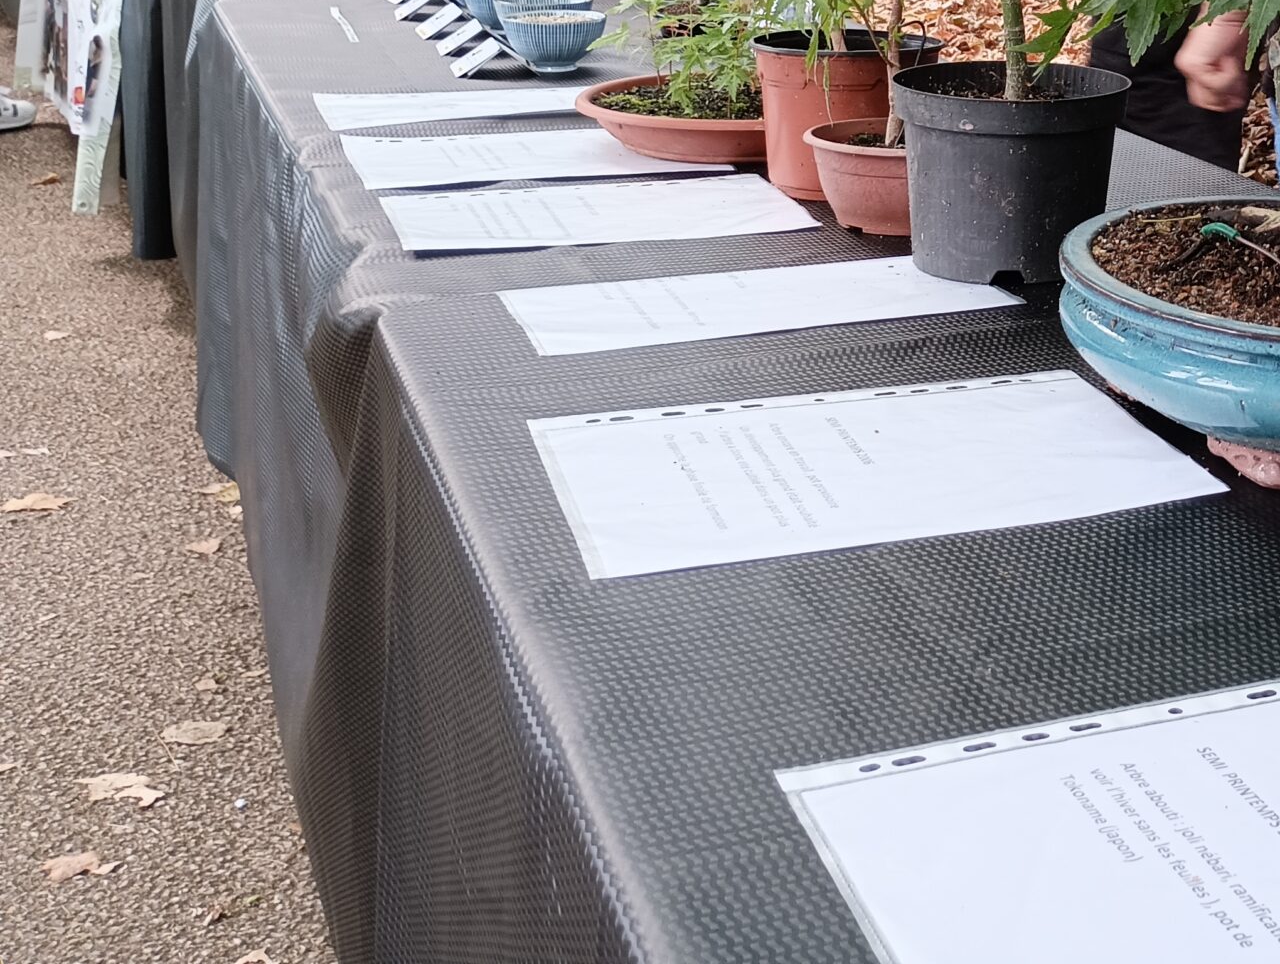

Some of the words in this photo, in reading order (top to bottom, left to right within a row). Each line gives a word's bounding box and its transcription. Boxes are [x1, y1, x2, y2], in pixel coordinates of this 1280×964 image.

[1196, 747, 1229, 770] SEMI
[1060, 774, 1107, 824] Tokoname
[1098, 825, 1144, 863] (japon)
[1090, 768, 1114, 786] voir
[1134, 816, 1160, 842] sans
[1154, 842, 1175, 859] les
[1169, 859, 1210, 899] feuilles
[1209, 911, 1240, 931] pot
[1233, 932, 1253, 948] de
[1119, 763, 1151, 788] Arbre
[1144, 789, 1184, 821] abouti
[1174, 826, 1205, 844] joli
[1194, 844, 1237, 883] nébari,
